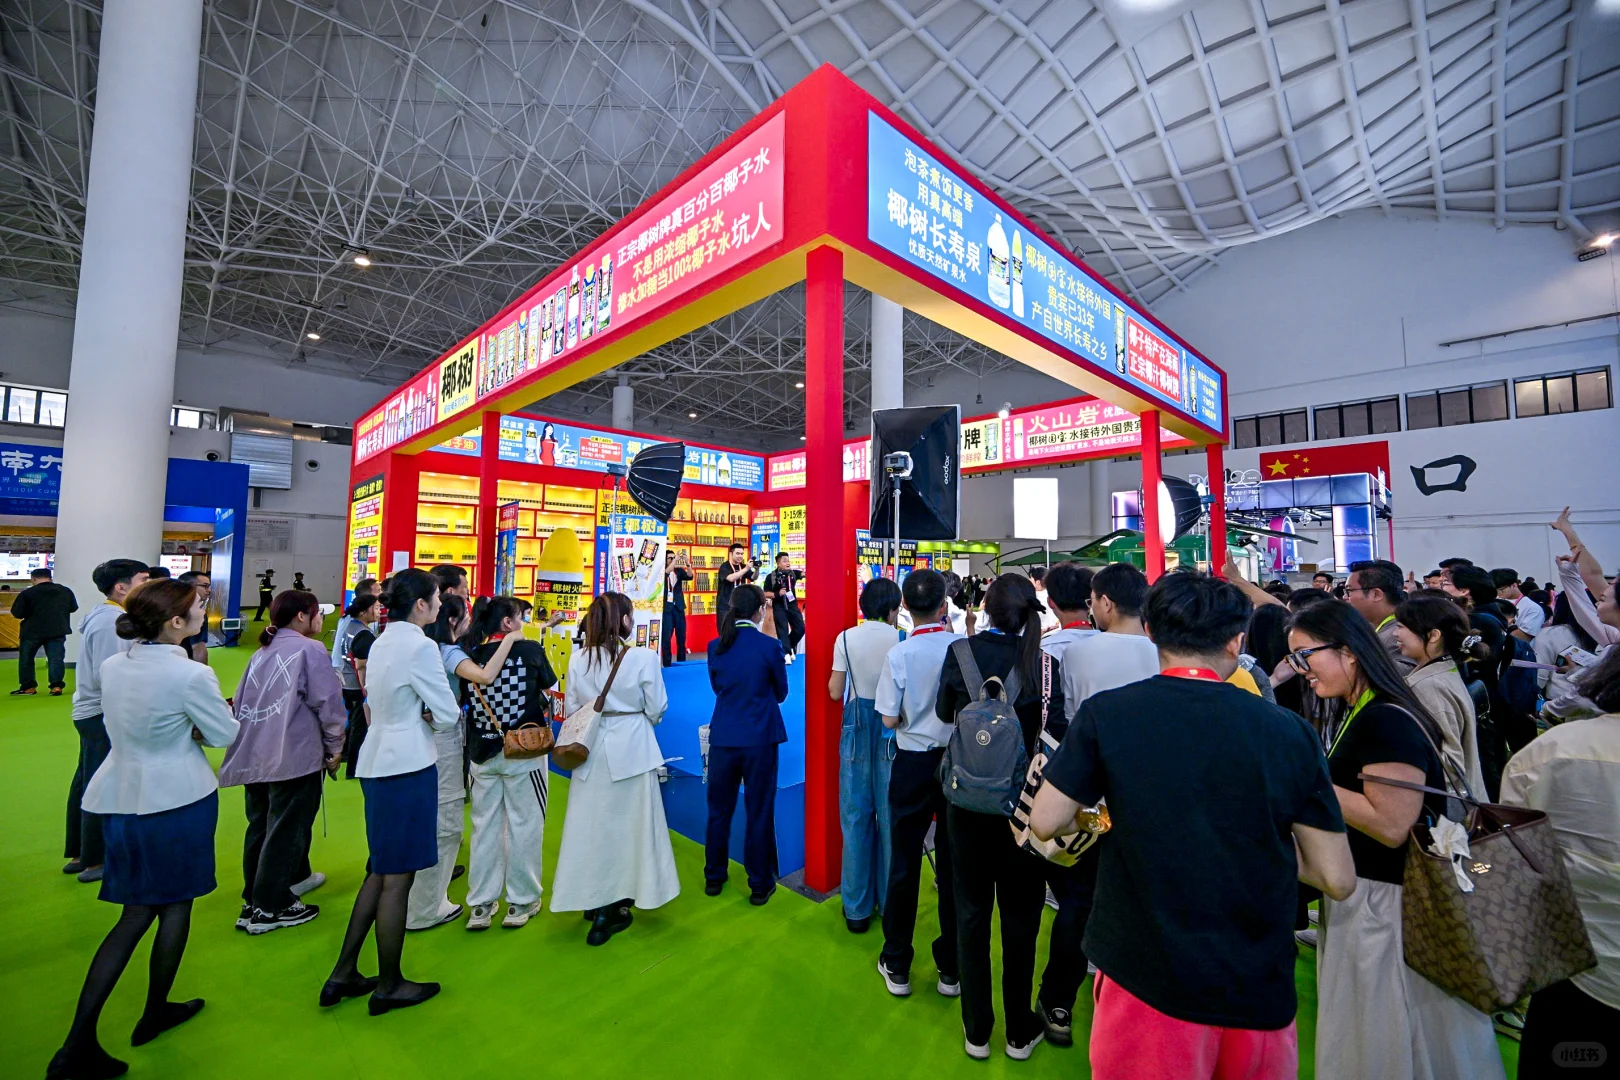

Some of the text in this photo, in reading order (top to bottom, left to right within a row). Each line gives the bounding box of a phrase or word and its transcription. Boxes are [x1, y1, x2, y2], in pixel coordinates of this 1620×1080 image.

[904, 147, 974, 214] 泡茶煮饭更香
[616, 147, 771, 268] 正宗椰树牌真百分百椰子水
[731, 201, 772, 250] 坑人
[917, 181, 963, 230] 用真高端
[632, 208, 725, 283] 不是用浓缩椰子水
[887, 187, 982, 276] 椰树长寿泉
[908, 237, 967, 283] 优质天然矿泉水
[1031, 301, 1107, 361] 产自世界长寿之乡
[1047, 285, 1095, 332] 贵宾已33年
[1128, 323, 1179, 375] 椰子特产在海南
[441, 347, 474, 403] 椰树
[500, 419, 525, 430] 更健康
[960, 426, 982, 450] 牌
[1027, 406, 1100, 433] 火山岩
[1410, 454, 1477, 496] 口
[615, 537, 634, 548] 豆奶
[624, 517, 657, 533] 椰树
